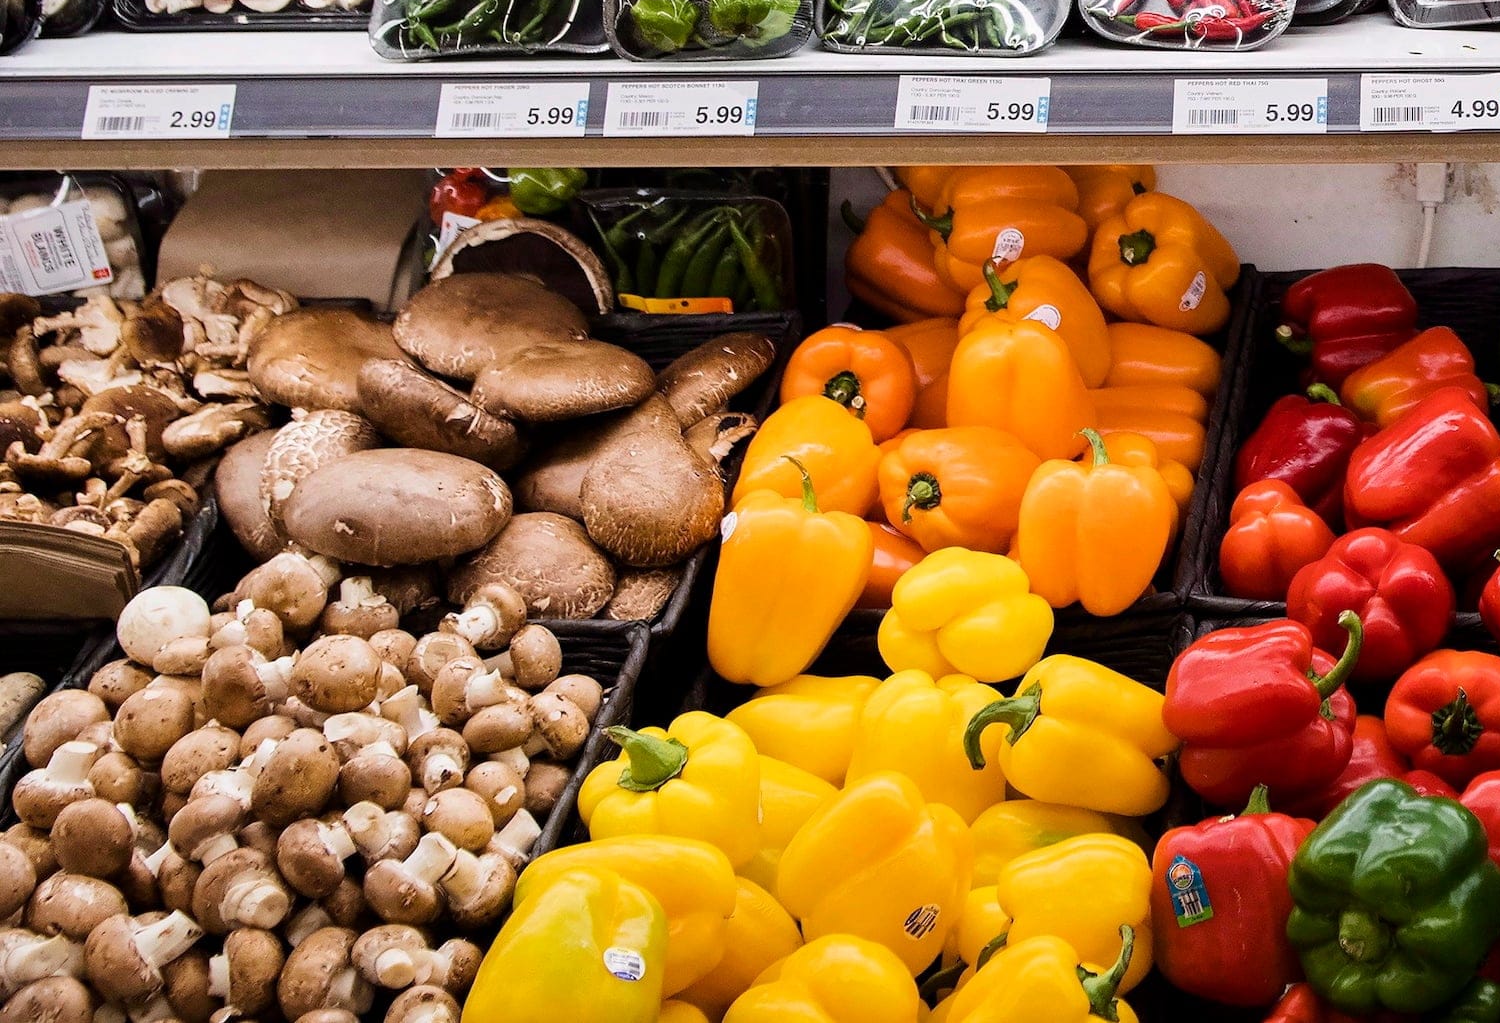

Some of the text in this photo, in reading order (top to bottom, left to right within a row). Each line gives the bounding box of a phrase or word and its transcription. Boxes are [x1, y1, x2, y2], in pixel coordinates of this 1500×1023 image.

[527, 107, 574, 125] 5.99
[695, 106, 743, 124] 5.99
[986, 102, 1034, 121] 5.99
[1265, 103, 1314, 122] 5.99
[1450, 100, 1500, 118] 4.99
[169, 110, 216, 128] 2.99
[31, 231, 55, 274] BLANCS
[53, 225, 76, 269] WHITE
